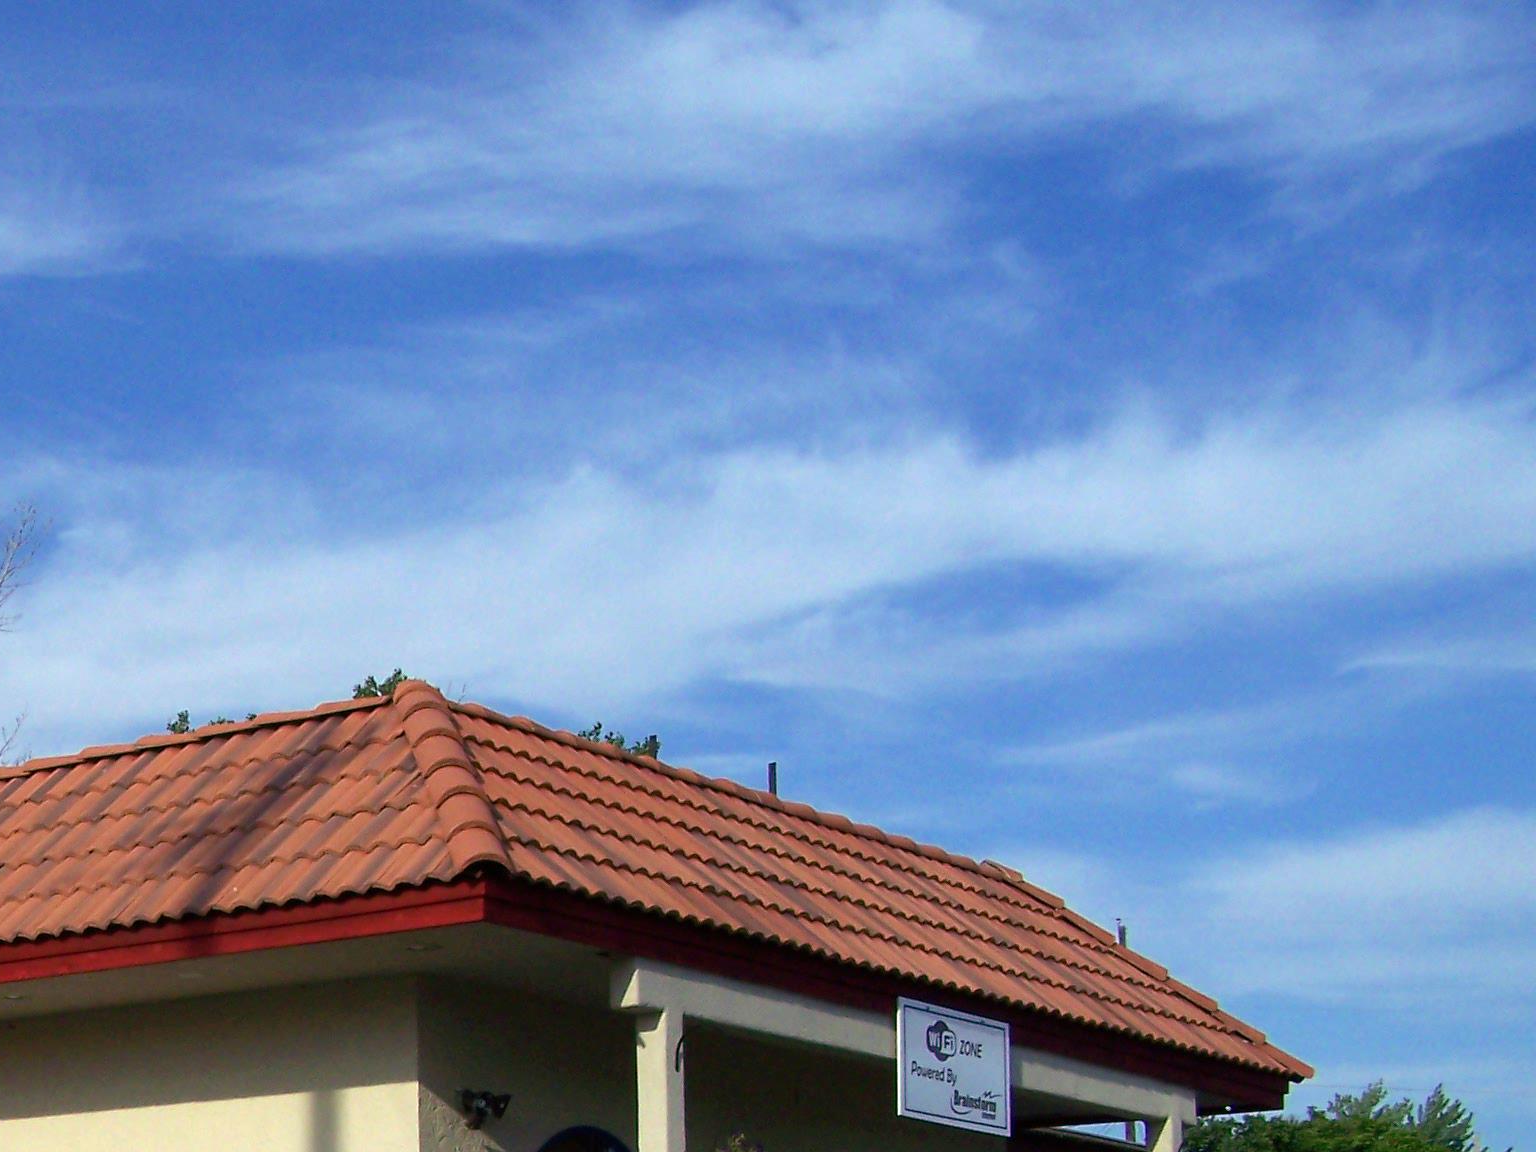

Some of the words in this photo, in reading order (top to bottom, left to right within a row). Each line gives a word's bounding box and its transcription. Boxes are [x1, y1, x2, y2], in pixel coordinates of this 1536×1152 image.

[959, 1039, 983, 1058] ZONE
[911, 1060, 945, 1081] Powered
[946, 1067, 958, 1087] By
